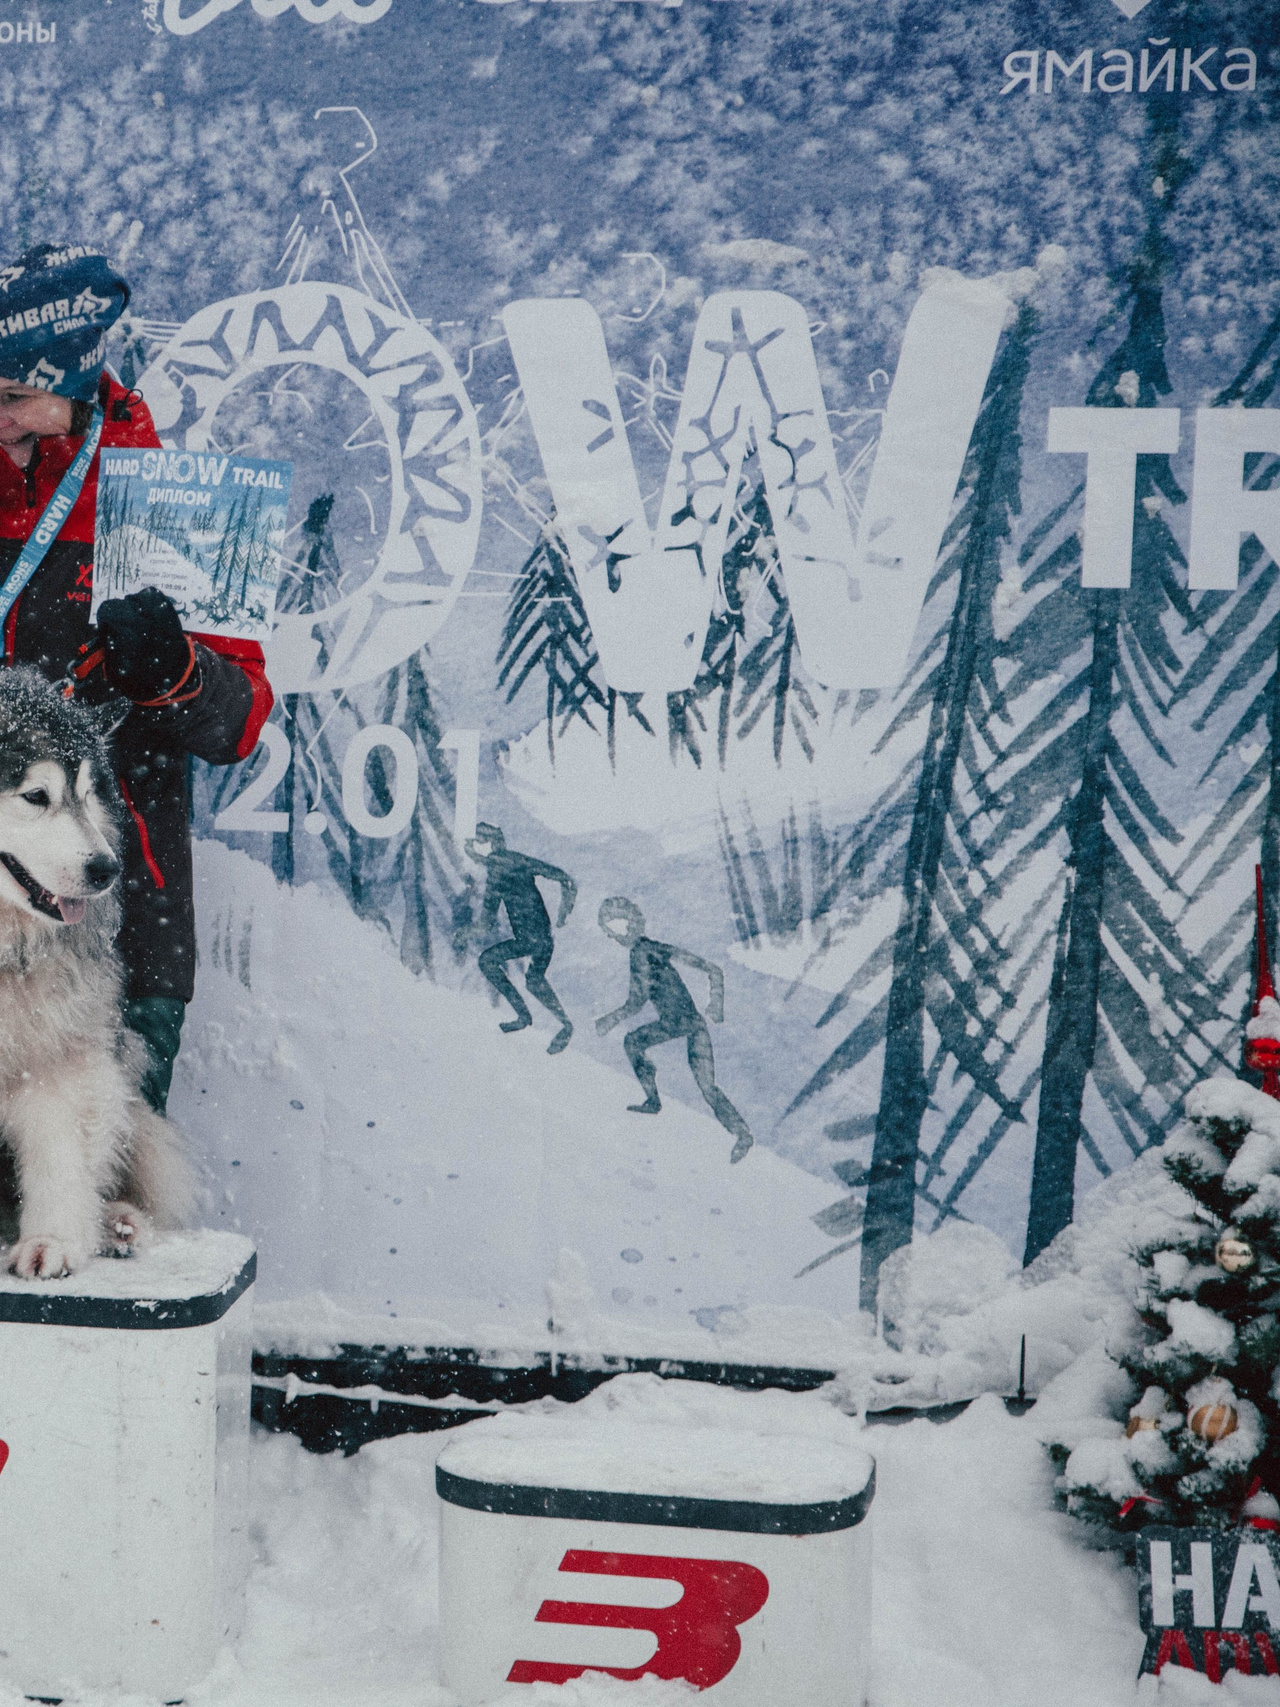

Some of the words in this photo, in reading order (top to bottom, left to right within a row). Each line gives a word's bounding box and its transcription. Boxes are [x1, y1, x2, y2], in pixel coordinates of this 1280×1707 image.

[104, 458, 140, 476] HARD
[141, 450, 229, 486] SNOW
[232, 467, 284, 489] TRAIL
[147, 487, 211, 506] ДИПЛОМ
[35, 494, 71, 545] HARD
[5, 559, 30, 594] SNOW
[506, 1549, 770, 1692] 3
